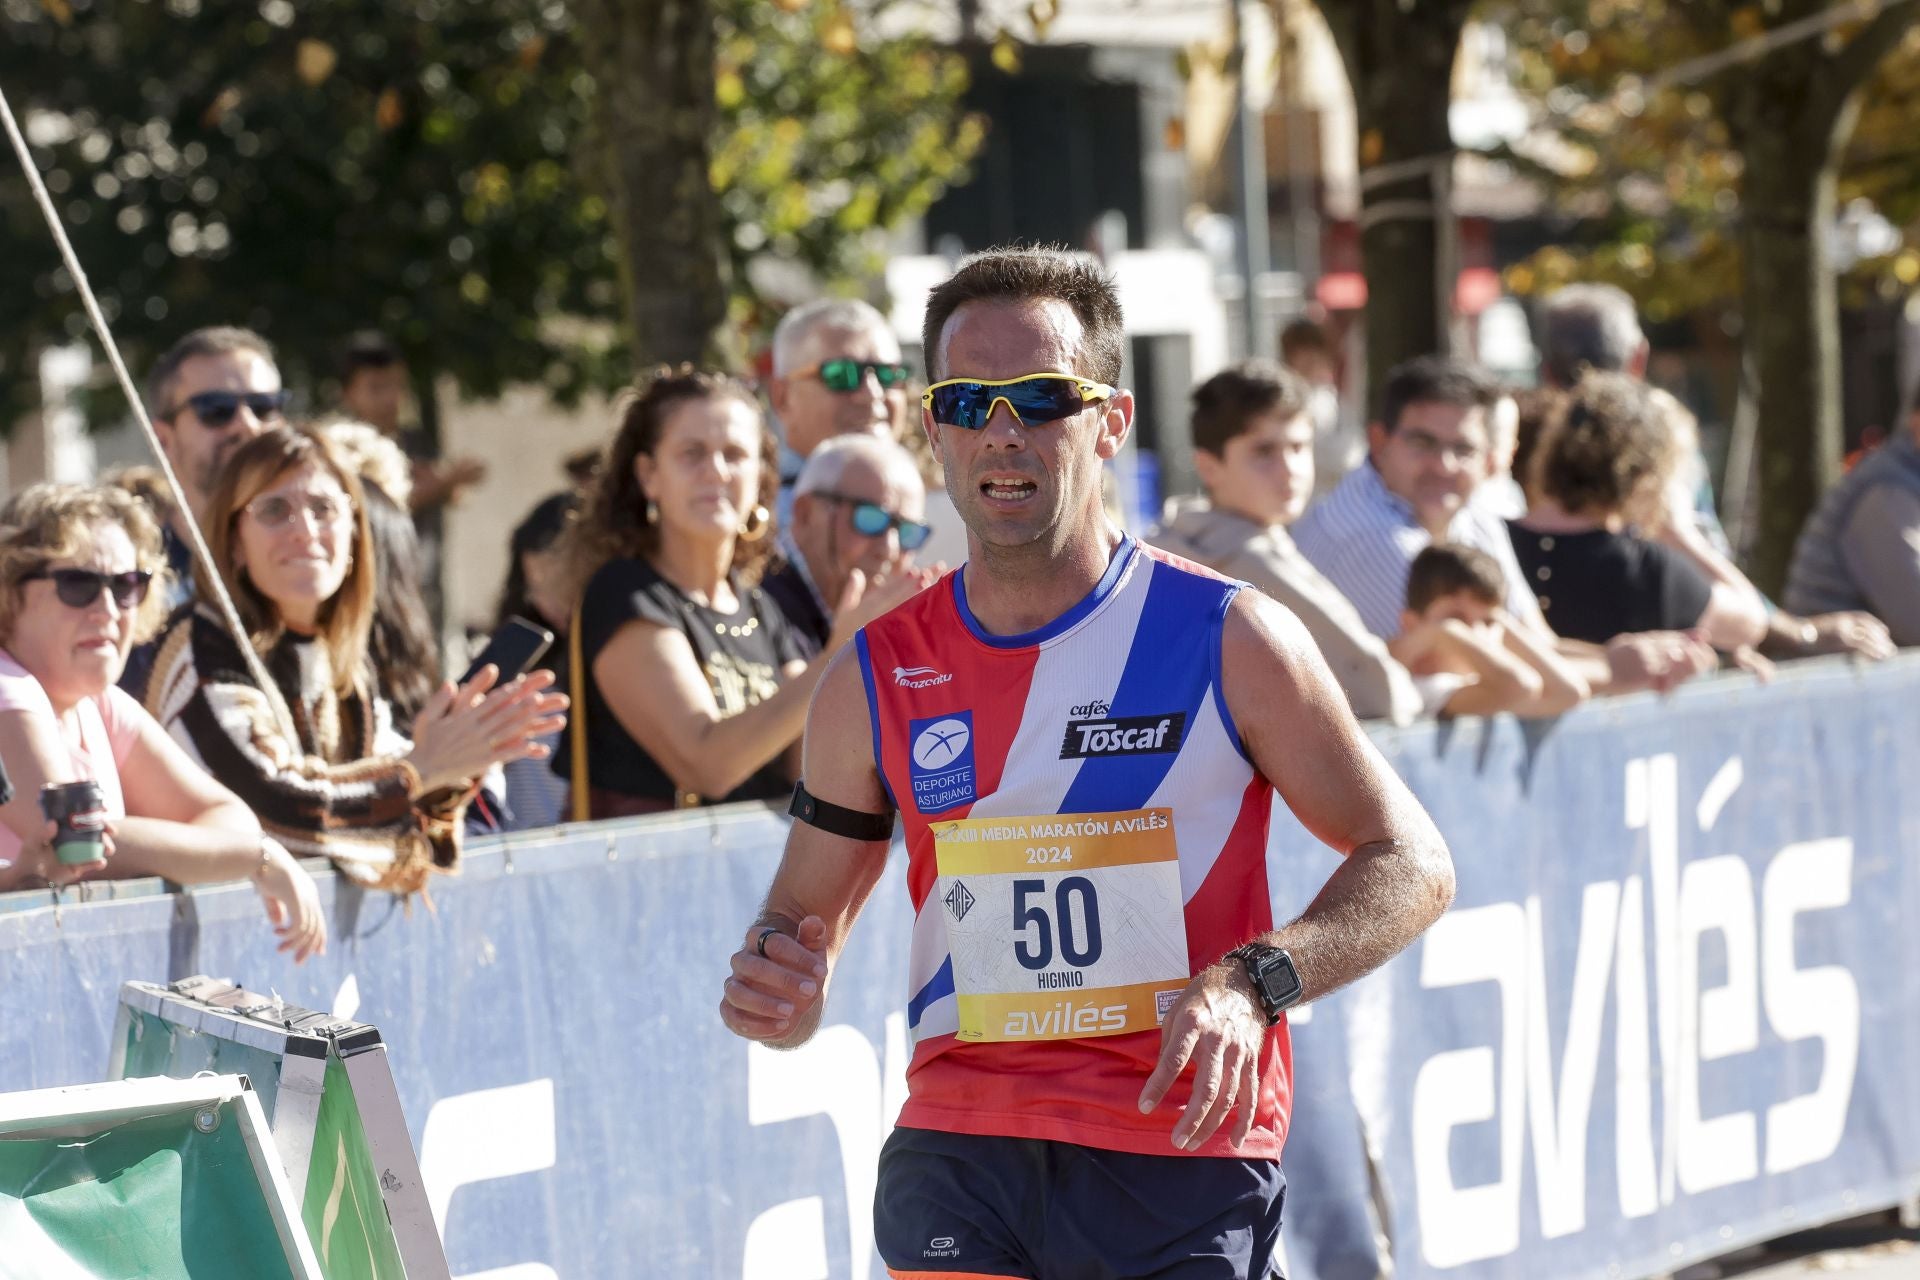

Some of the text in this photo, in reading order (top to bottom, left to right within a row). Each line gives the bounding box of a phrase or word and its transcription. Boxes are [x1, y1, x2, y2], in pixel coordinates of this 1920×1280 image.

[1070, 700, 1110, 719] cafés
[1076, 719, 1170, 753] Toscaf
[914, 772, 971, 793] DEPORTE
[918, 784, 973, 807] ASTURIANO
[981, 827, 1028, 841] MEDIA
[1031, 818, 1109, 839] MARATÓN
[1113, 811, 1168, 833] AVILÉS
[1025, 846, 1073, 865] 2024
[1013, 876, 1103, 970] 50
[1037, 971, 1084, 989] HIGINIO
[1004, 1001, 1128, 1036] avilés
[1412, 752, 1860, 1269] avilés
[923, 1248, 960, 1258] Kalenji
